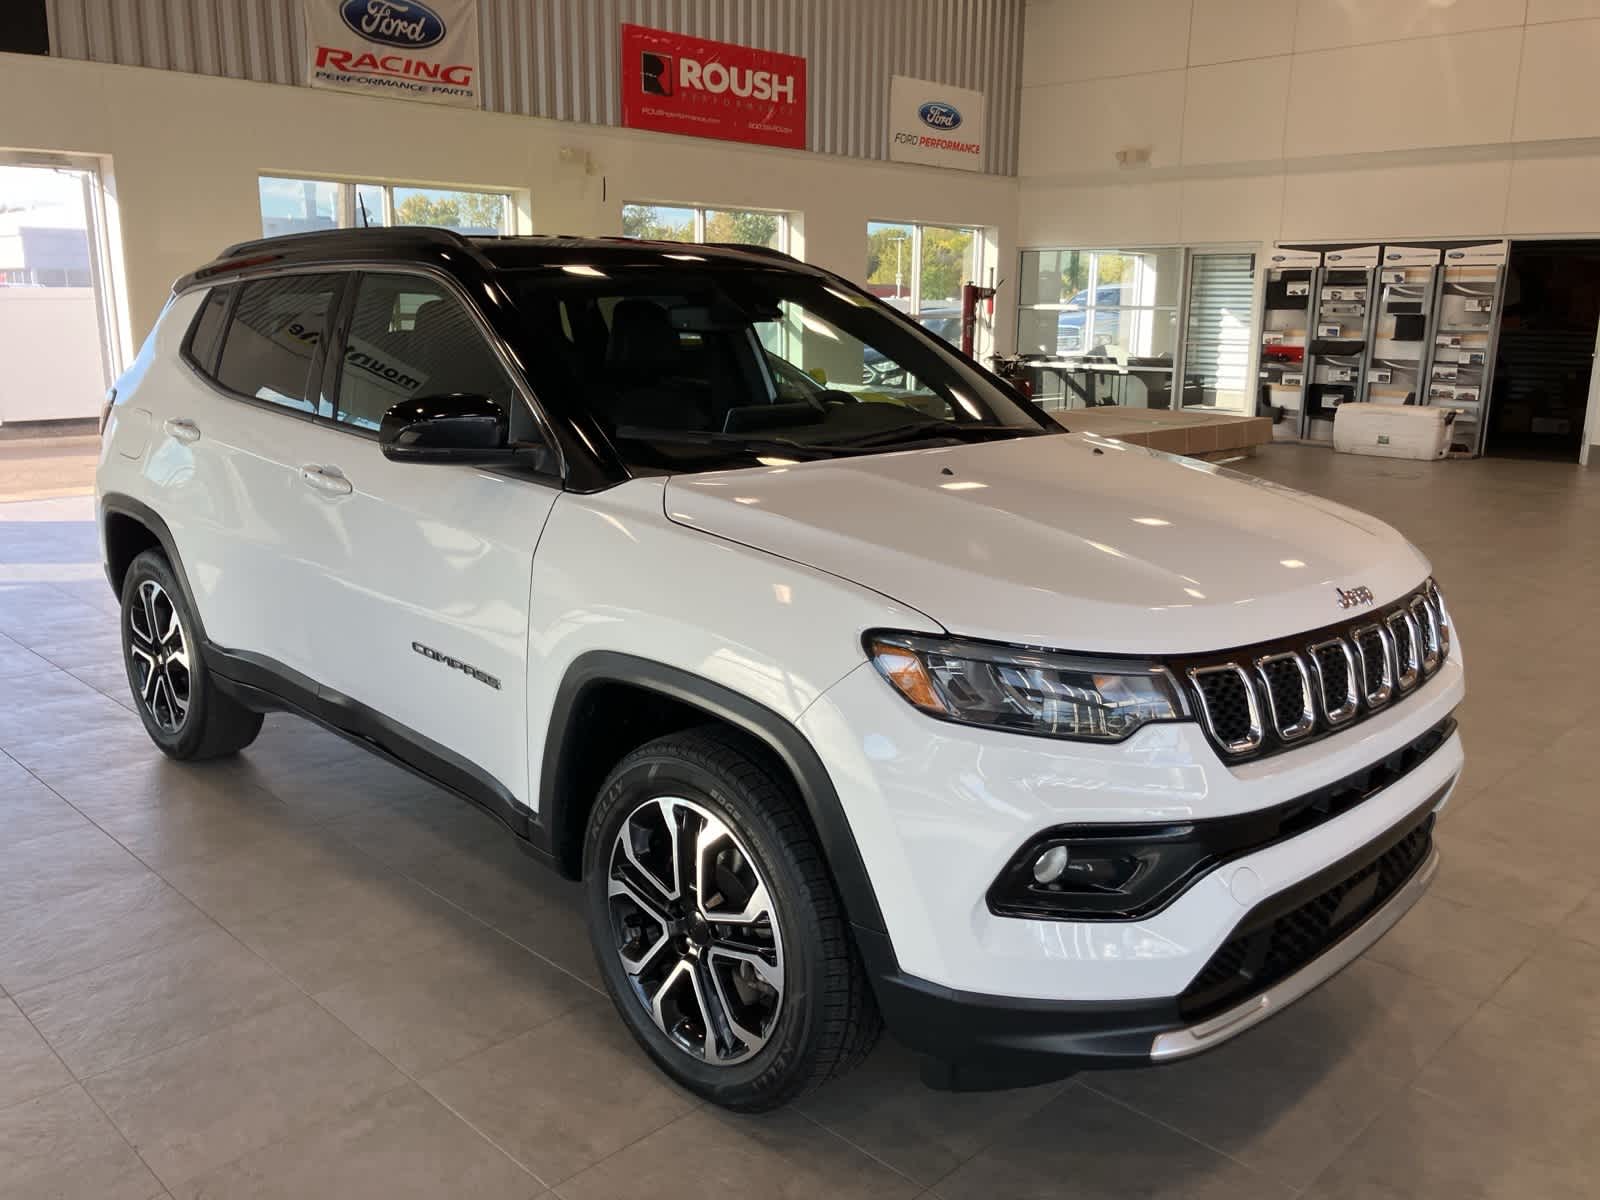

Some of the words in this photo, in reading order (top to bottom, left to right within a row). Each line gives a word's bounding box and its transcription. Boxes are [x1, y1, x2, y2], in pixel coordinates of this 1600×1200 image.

[362, 1, 427, 41] Ford
[315, 46, 473, 87] RACING
[679, 57, 795, 104] ROUSH
[315, 71, 427, 92] PERFORMANCE
[431, 86, 474, 97] PARTS
[926, 105, 955, 126] Ford
[894, 132, 919, 146] FORD
[919, 135, 981, 155] PERFORMANCE
[1336, 585, 1374, 609] Jeep
[411, 641, 502, 690] COMPASS
